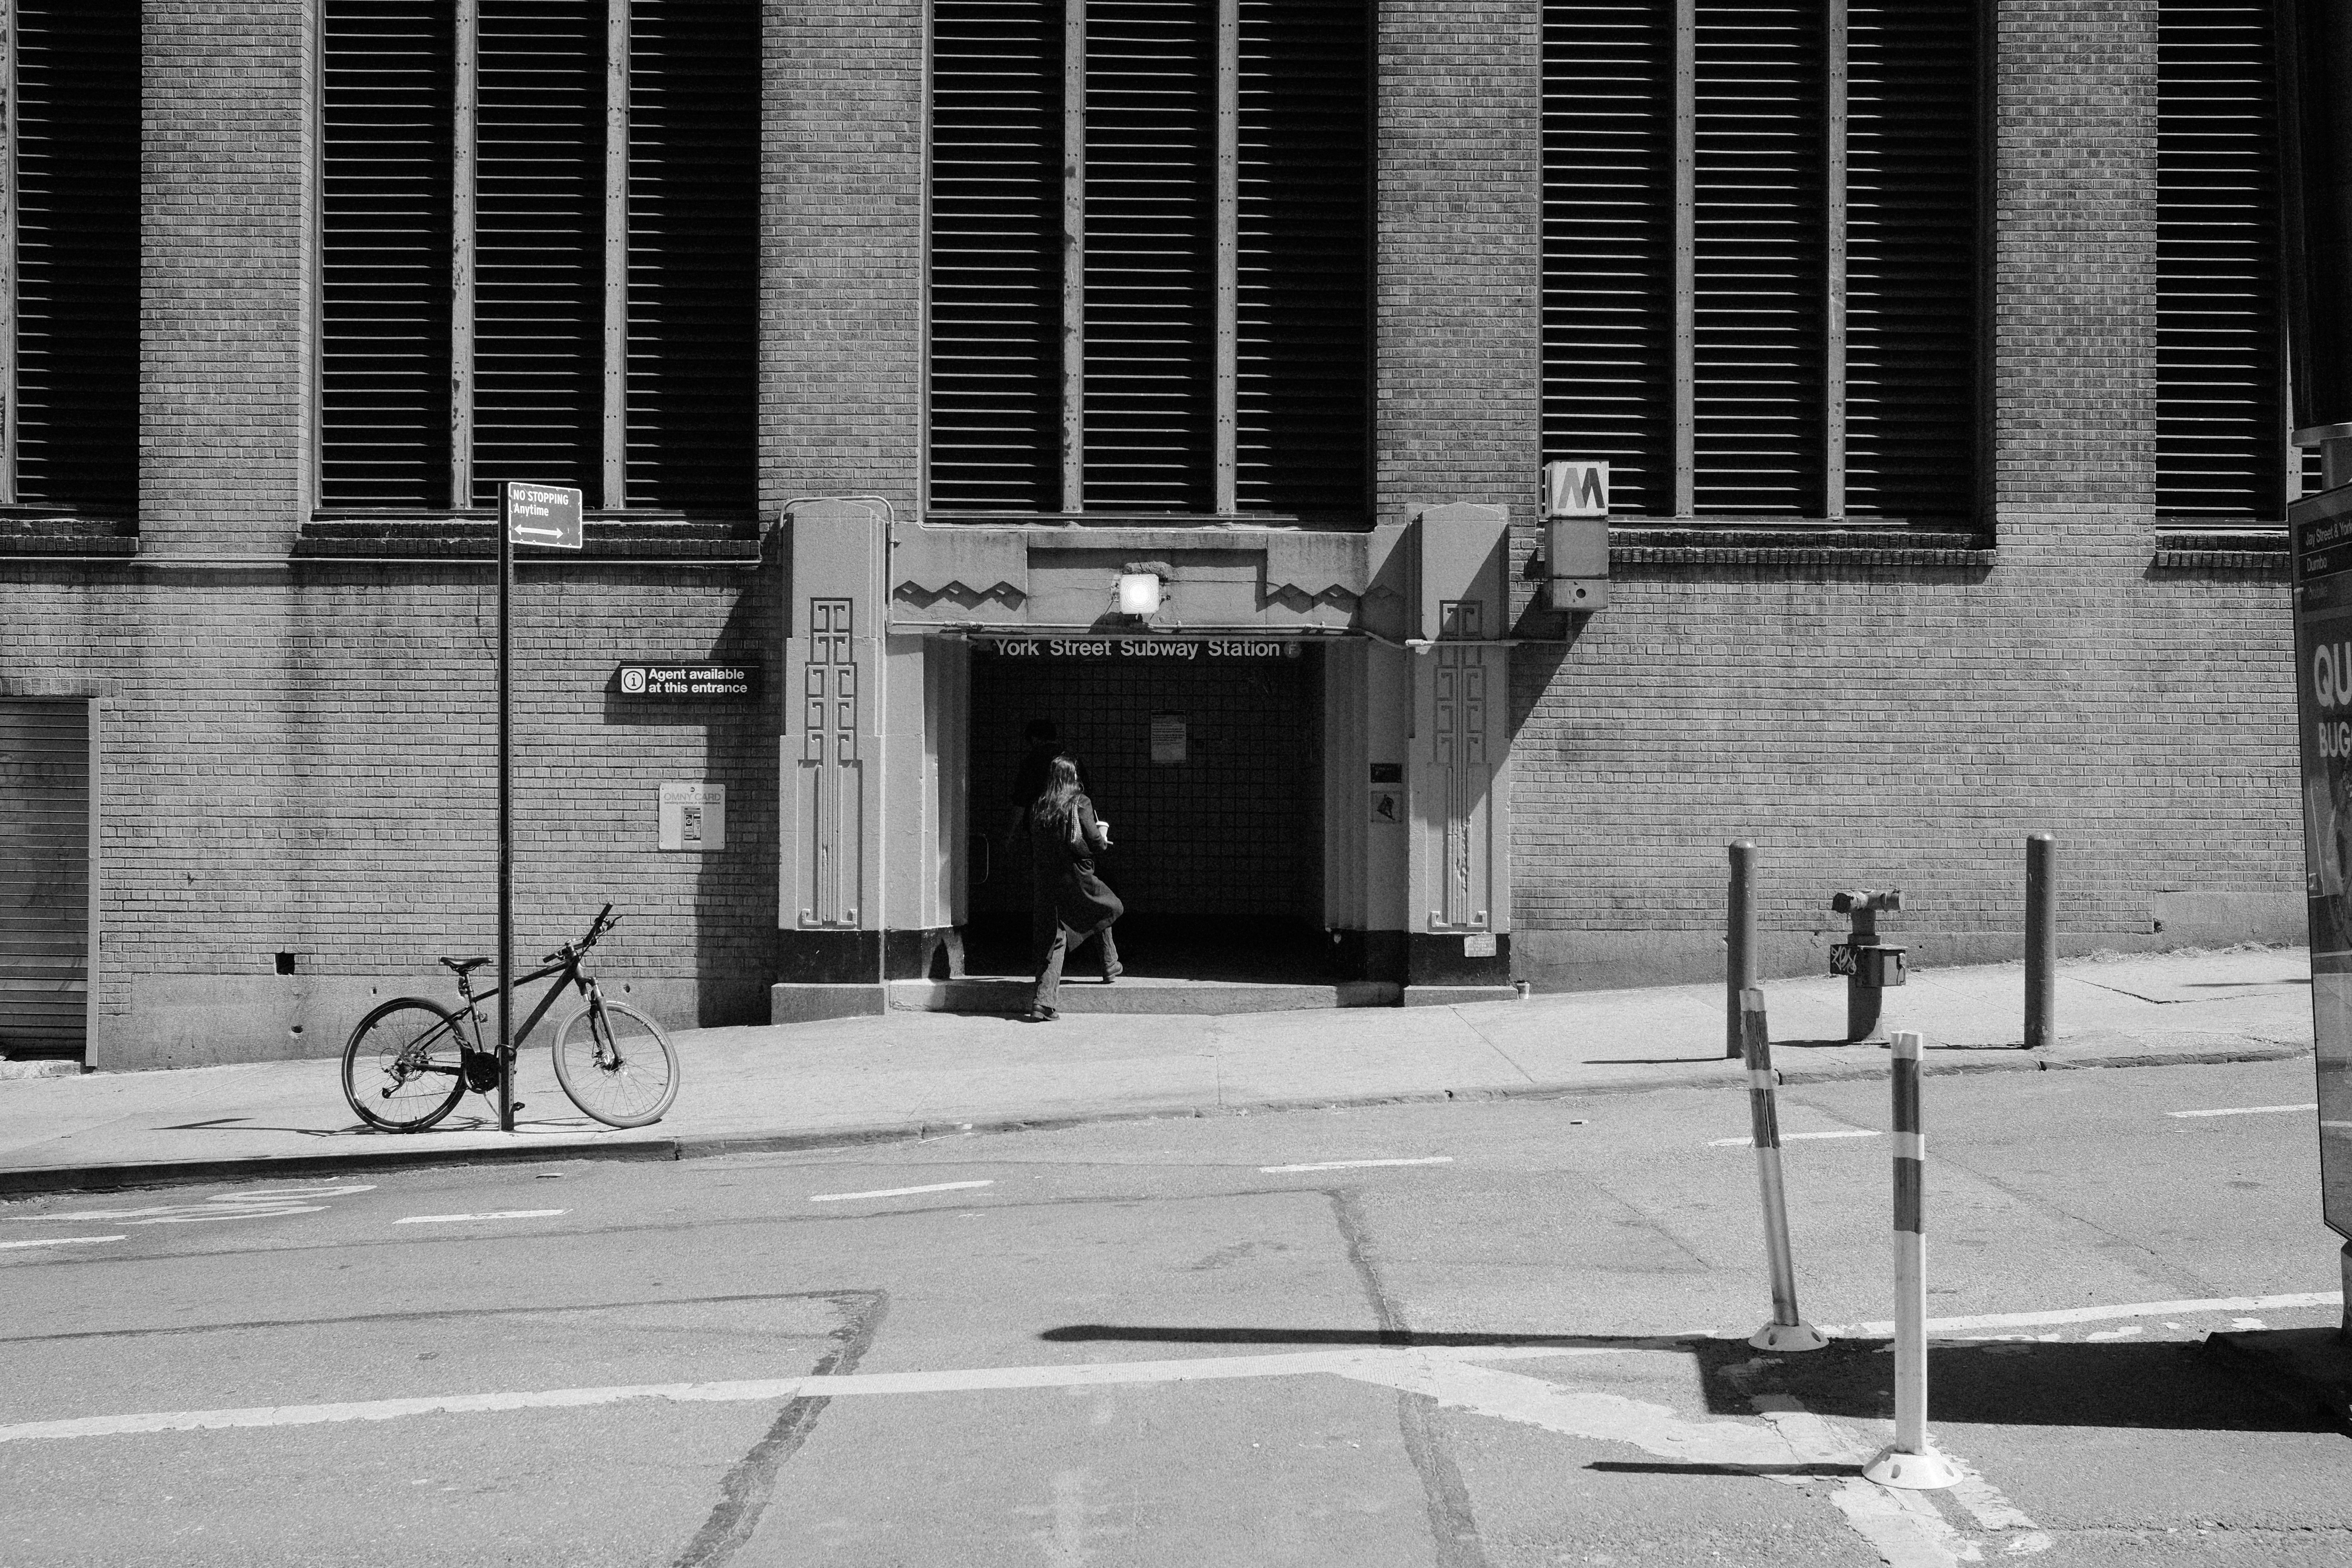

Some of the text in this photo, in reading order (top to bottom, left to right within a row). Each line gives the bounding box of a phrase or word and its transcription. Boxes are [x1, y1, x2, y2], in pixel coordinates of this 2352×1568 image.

[1557, 467, 1605, 508] M
[513, 489, 568, 505] NO STOPPING
[514, 503, 549, 517] Anytime
[2306, 532, 2315, 547] Jay
[2316, 525, 2333, 543] Street
[2334, 524, 2339, 538] &
[2307, 555, 2327, 572] Dumbo
[995, 639, 1297, 660] York Street Subway Station F
[648, 669, 744, 681] Agent available
[648, 682, 747, 693] at this entrance
